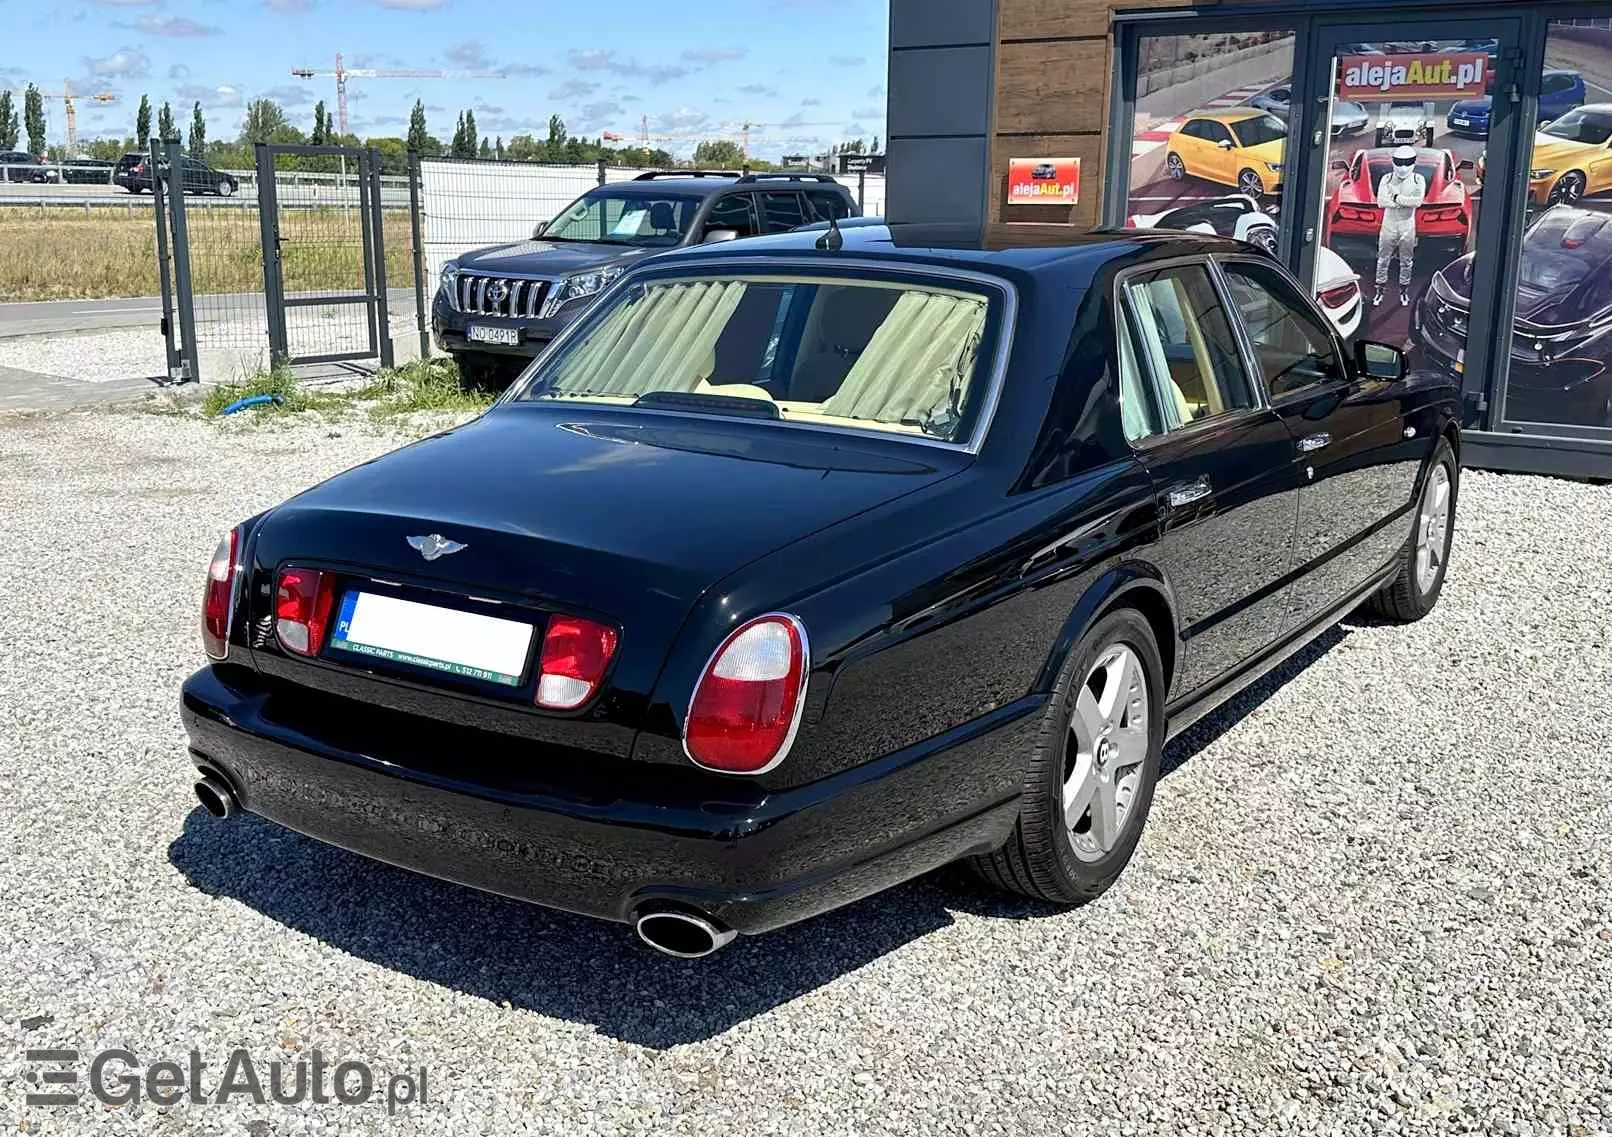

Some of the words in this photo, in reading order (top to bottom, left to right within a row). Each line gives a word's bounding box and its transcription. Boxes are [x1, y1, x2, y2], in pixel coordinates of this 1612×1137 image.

[1344, 58, 1483, 92] alejaAut.pl
[1012, 182, 1075, 198] alejaAut.pl
[339, 620, 350, 632] PL
[352, 643, 376, 655] CLASSIC
[376, 648, 393, 658] PARTS
